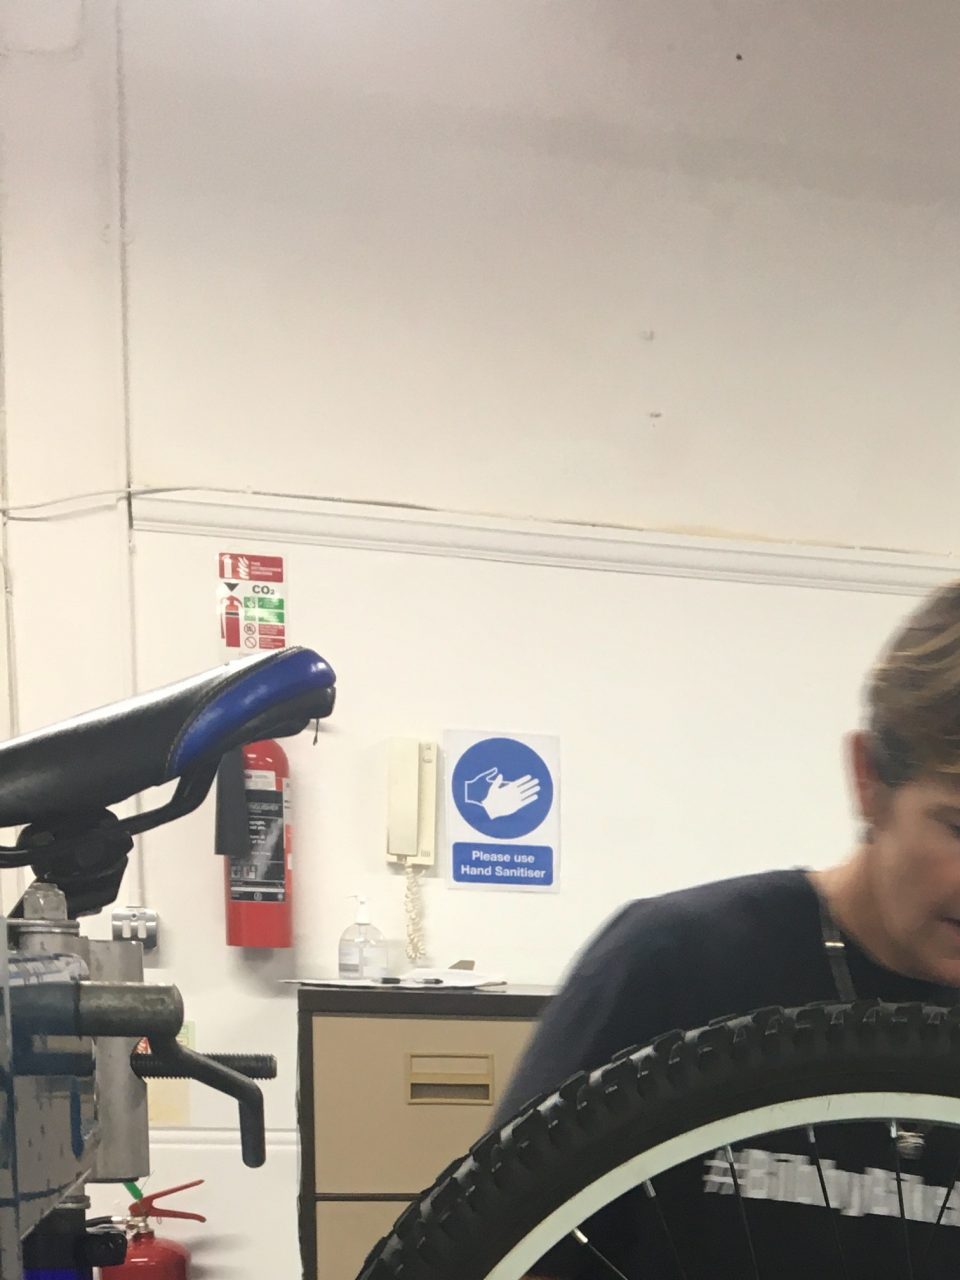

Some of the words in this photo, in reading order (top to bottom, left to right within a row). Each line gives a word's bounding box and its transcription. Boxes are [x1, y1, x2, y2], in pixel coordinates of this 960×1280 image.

[471, 850, 511, 862] Please
[513, 854, 535, 863] use
[460, 864, 492, 876] Hand
[495, 866, 546, 878] Sanitiser
